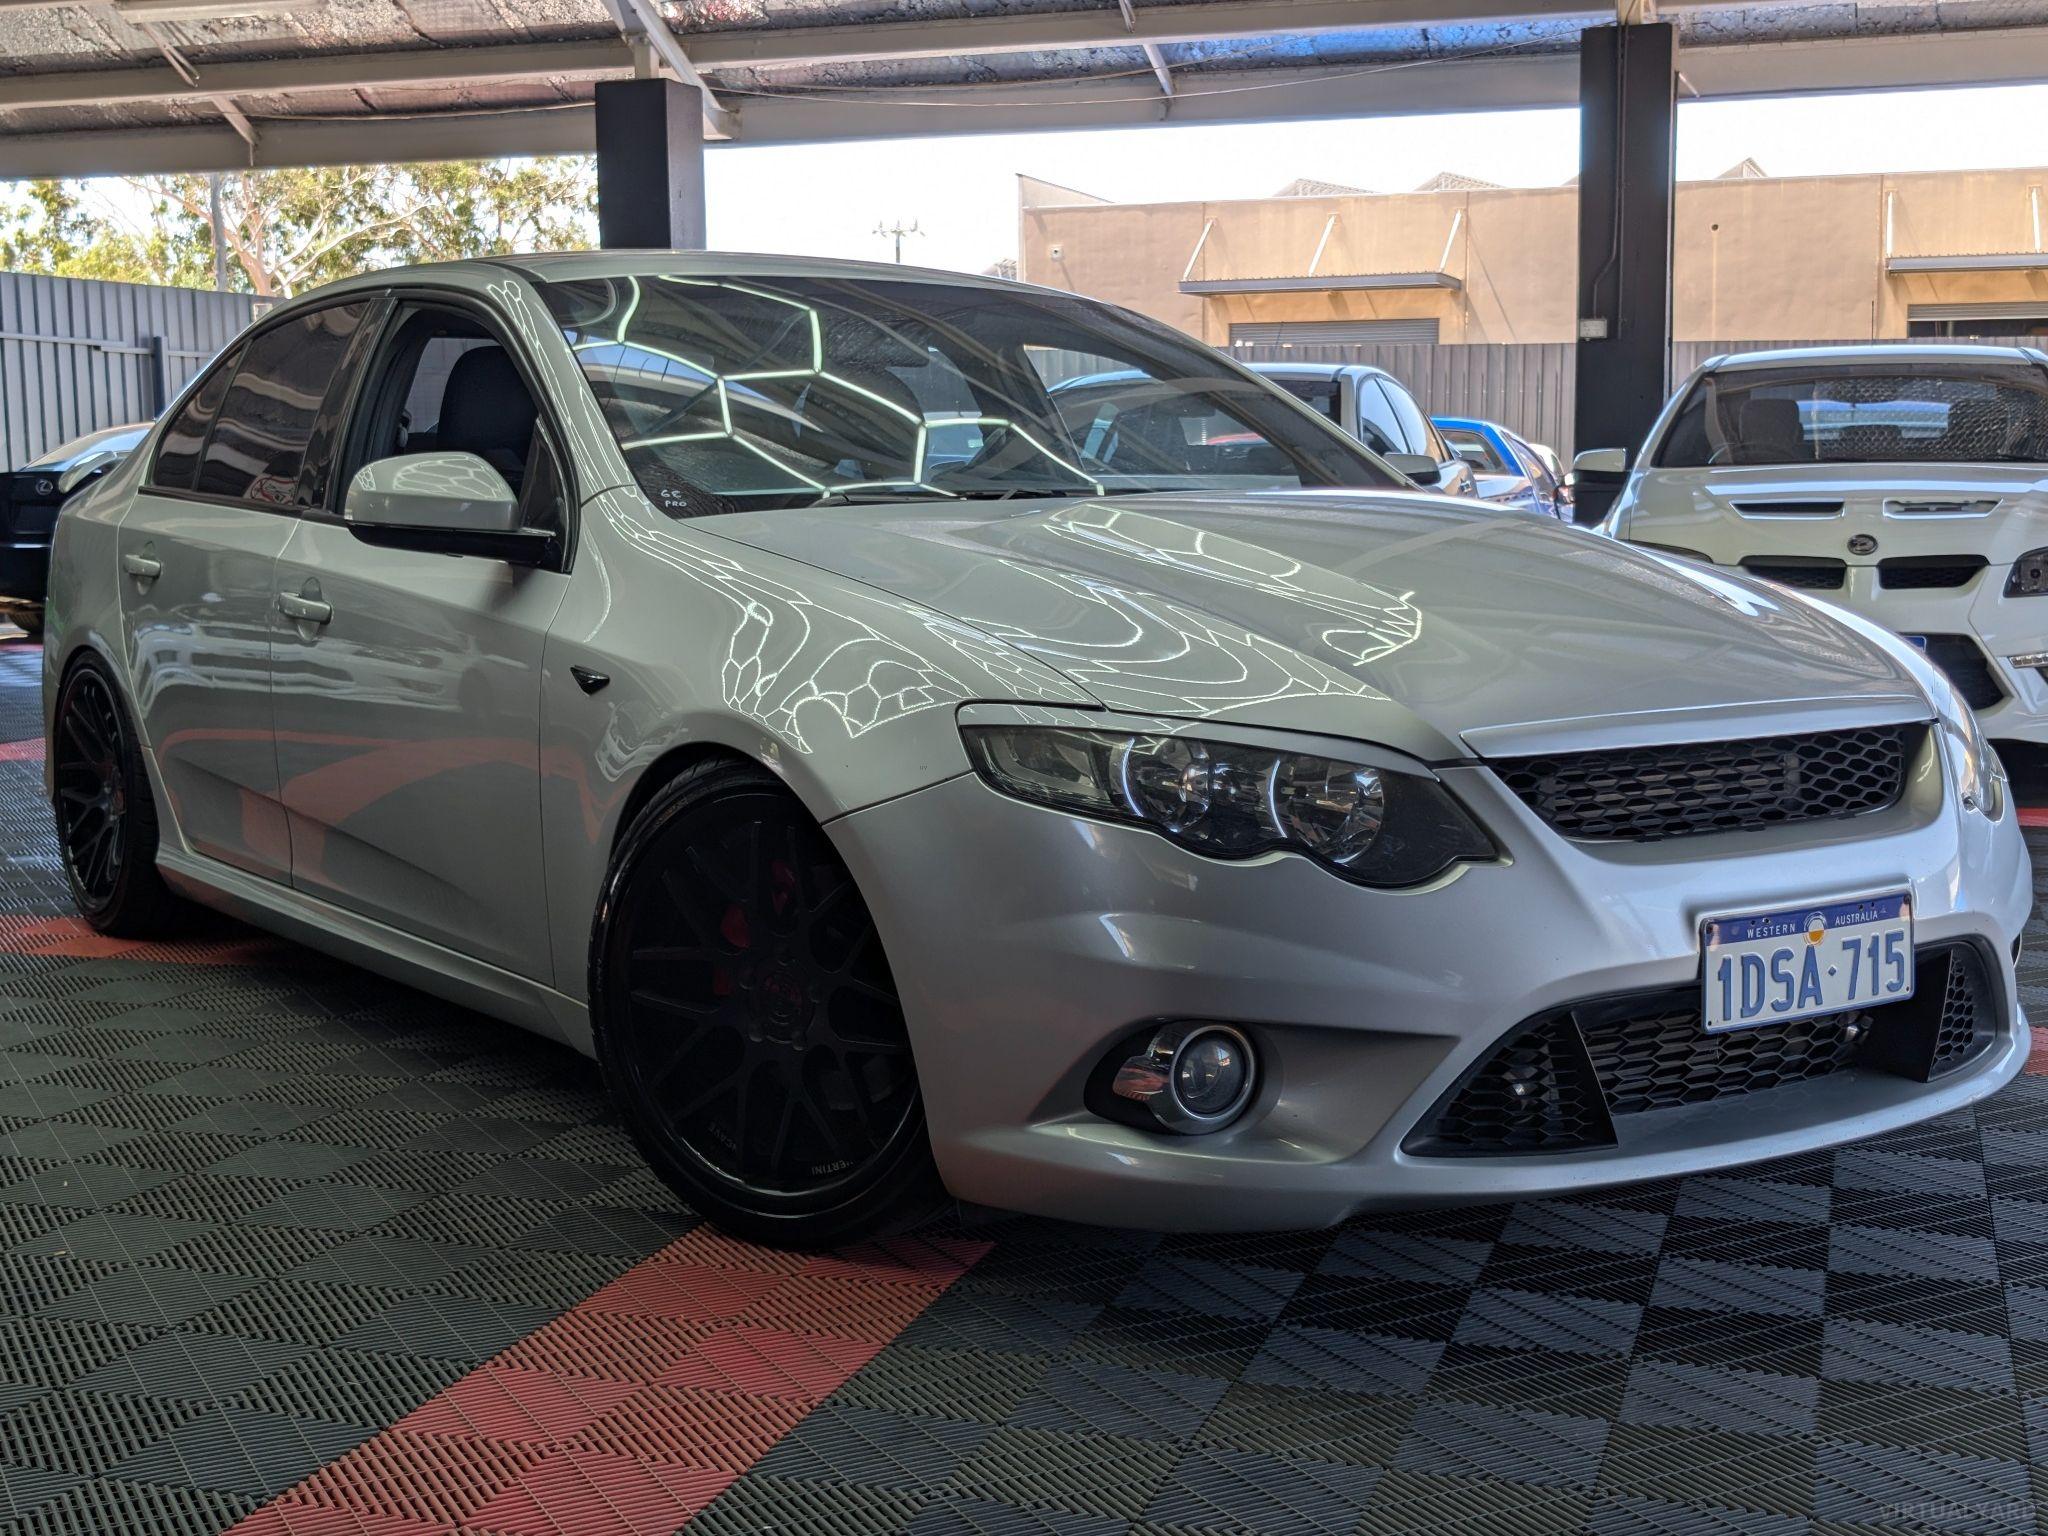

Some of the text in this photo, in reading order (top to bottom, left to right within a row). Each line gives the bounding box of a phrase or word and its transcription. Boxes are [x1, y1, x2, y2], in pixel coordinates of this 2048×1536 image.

[665, 500, 688, 508] PRO
[1746, 912, 1878, 939] WESTERN AUSTRALIA
